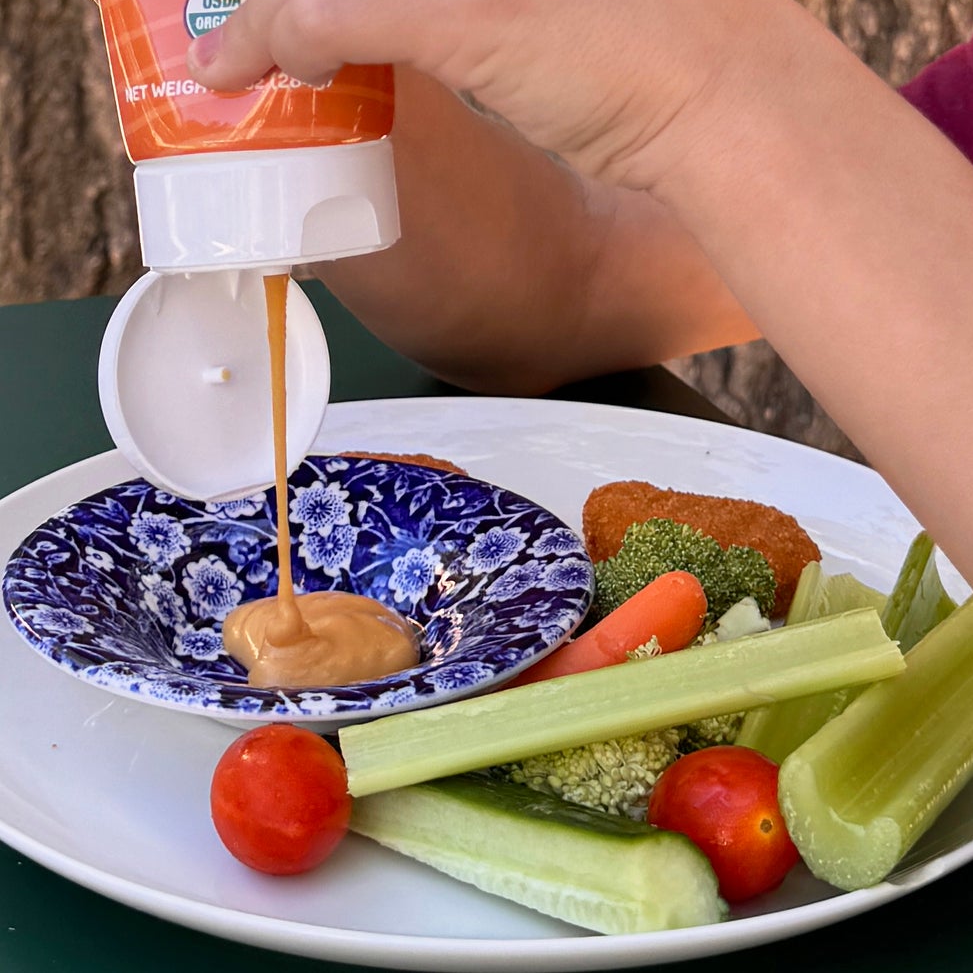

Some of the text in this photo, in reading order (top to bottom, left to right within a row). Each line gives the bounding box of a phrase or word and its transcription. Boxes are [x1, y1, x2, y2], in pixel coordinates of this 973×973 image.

[195, 15, 227, 30] ORGA
[125, 84, 148, 103] NET
[151, 79, 214, 98] WEIGH
